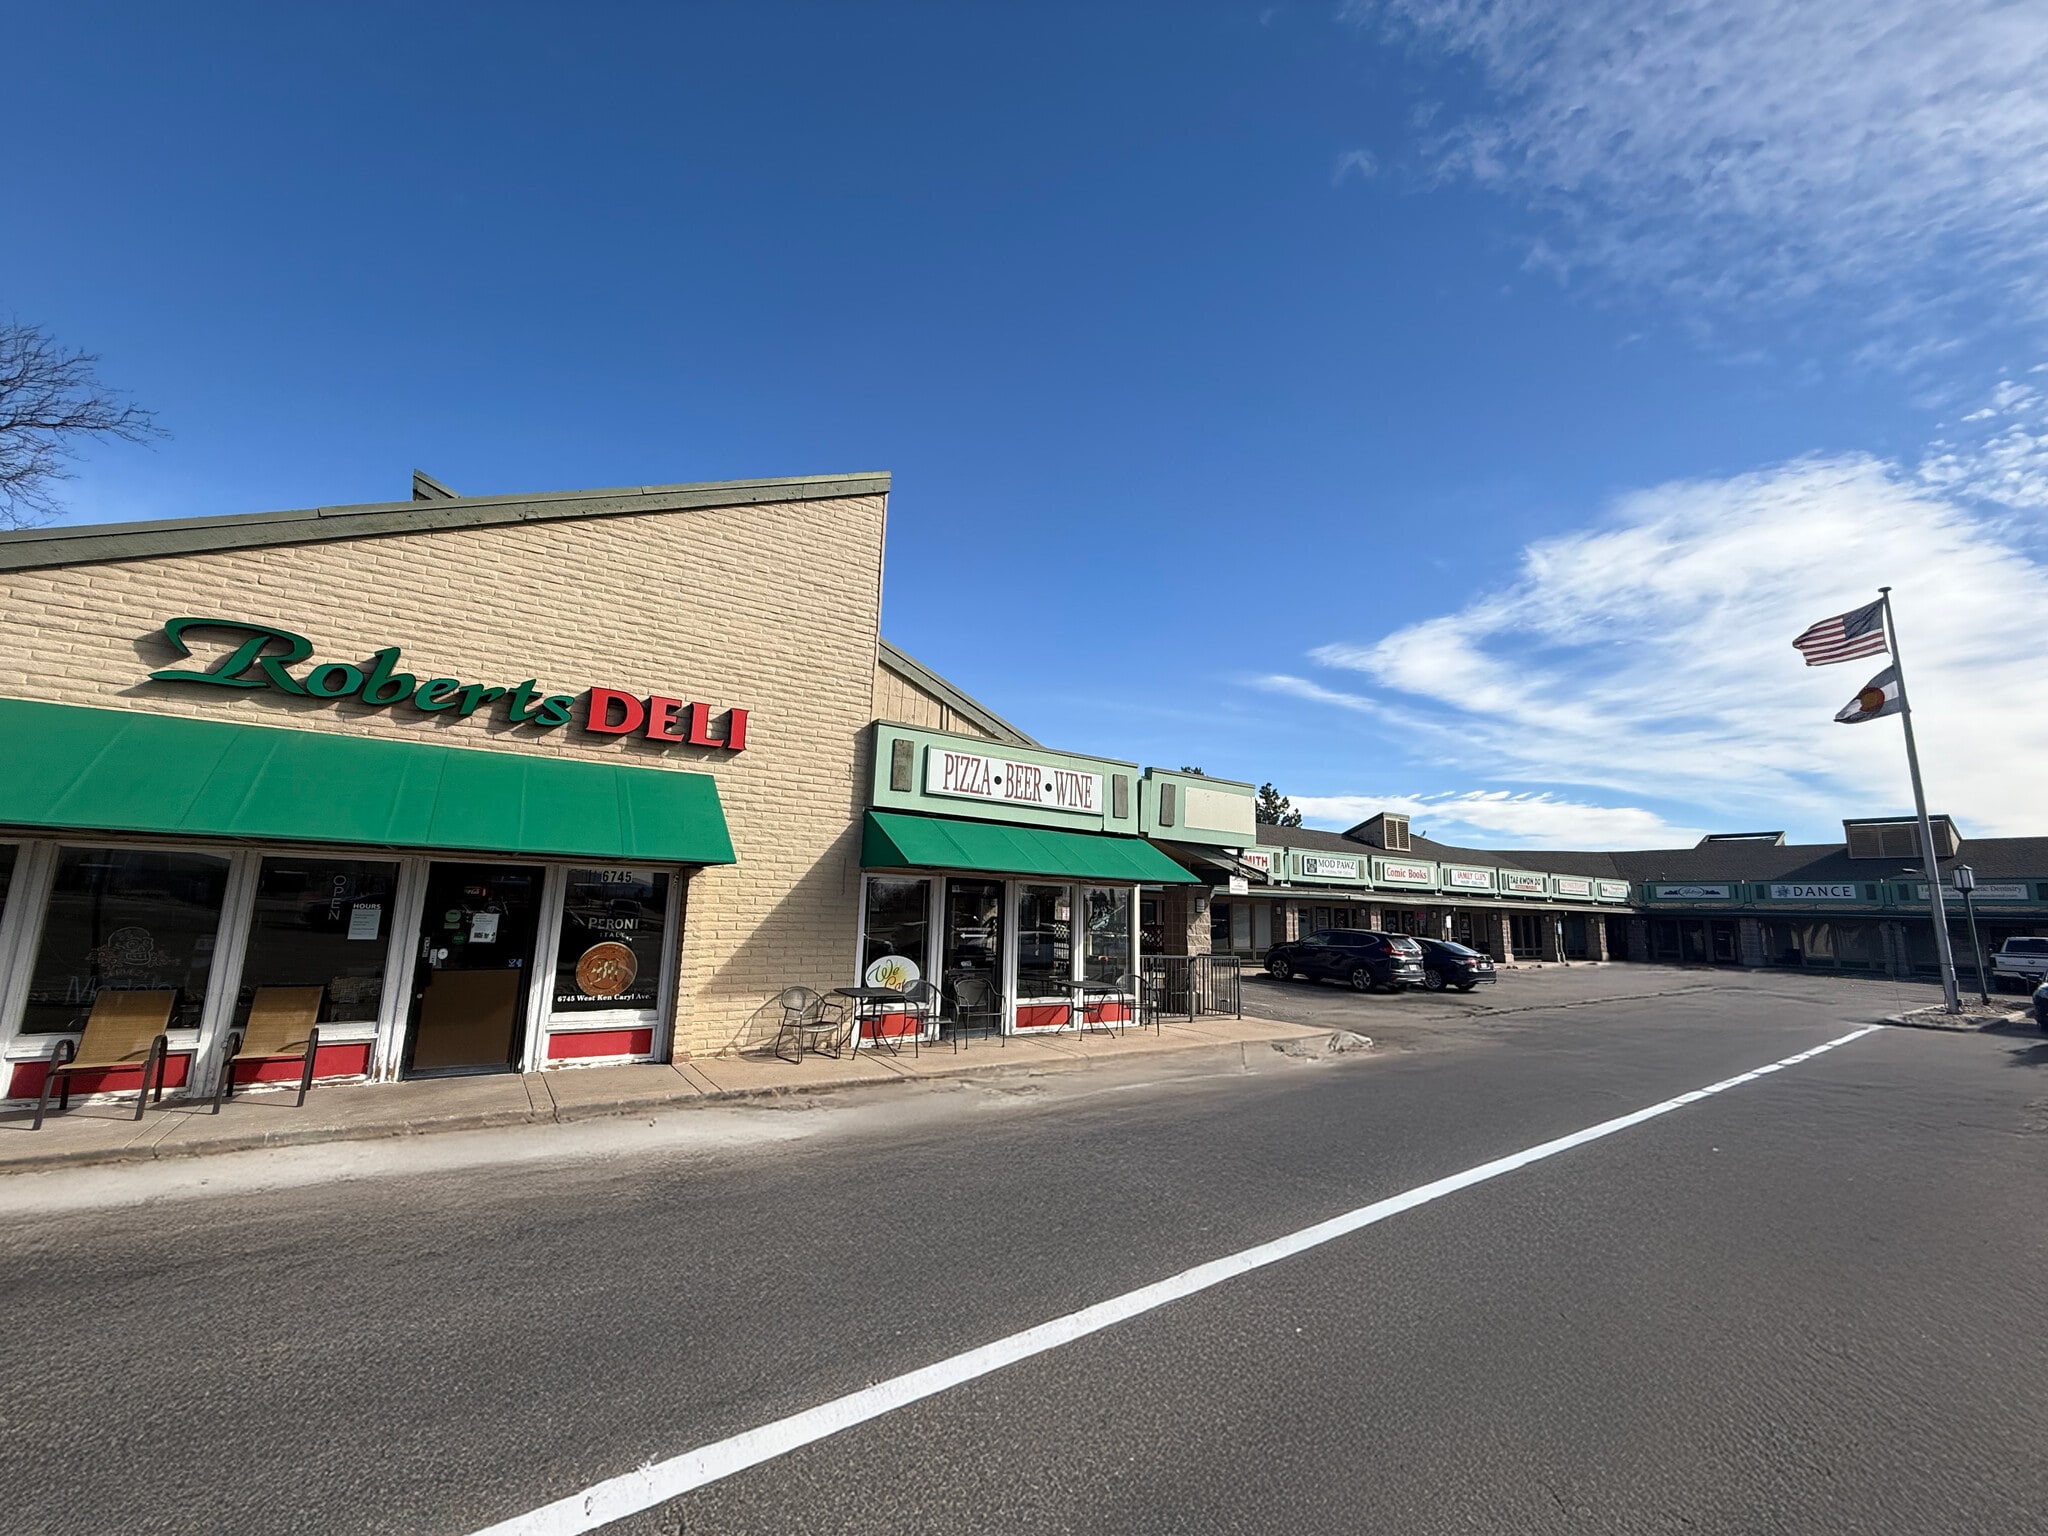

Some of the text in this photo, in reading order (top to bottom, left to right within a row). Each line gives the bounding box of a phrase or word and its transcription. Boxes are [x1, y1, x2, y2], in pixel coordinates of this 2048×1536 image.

[148, 617, 749, 750] Roberts DELI
[942, 753, 1093, 809] PIZZA BEER WINE
[1318, 859, 1355, 870] MOD PAWZ
[602, 870, 632, 883] 6745
[1386, 867, 1427, 880] Comic Books
[1510, 875, 1541, 886] TAE KWON DO
[328, 875, 347, 921] OPEN
[1793, 886, 1852, 897] DANCE
[588, 917, 640, 930] PERONI
[867, 959, 900, 983] We
[614, 993, 635, 1001] Caryl
